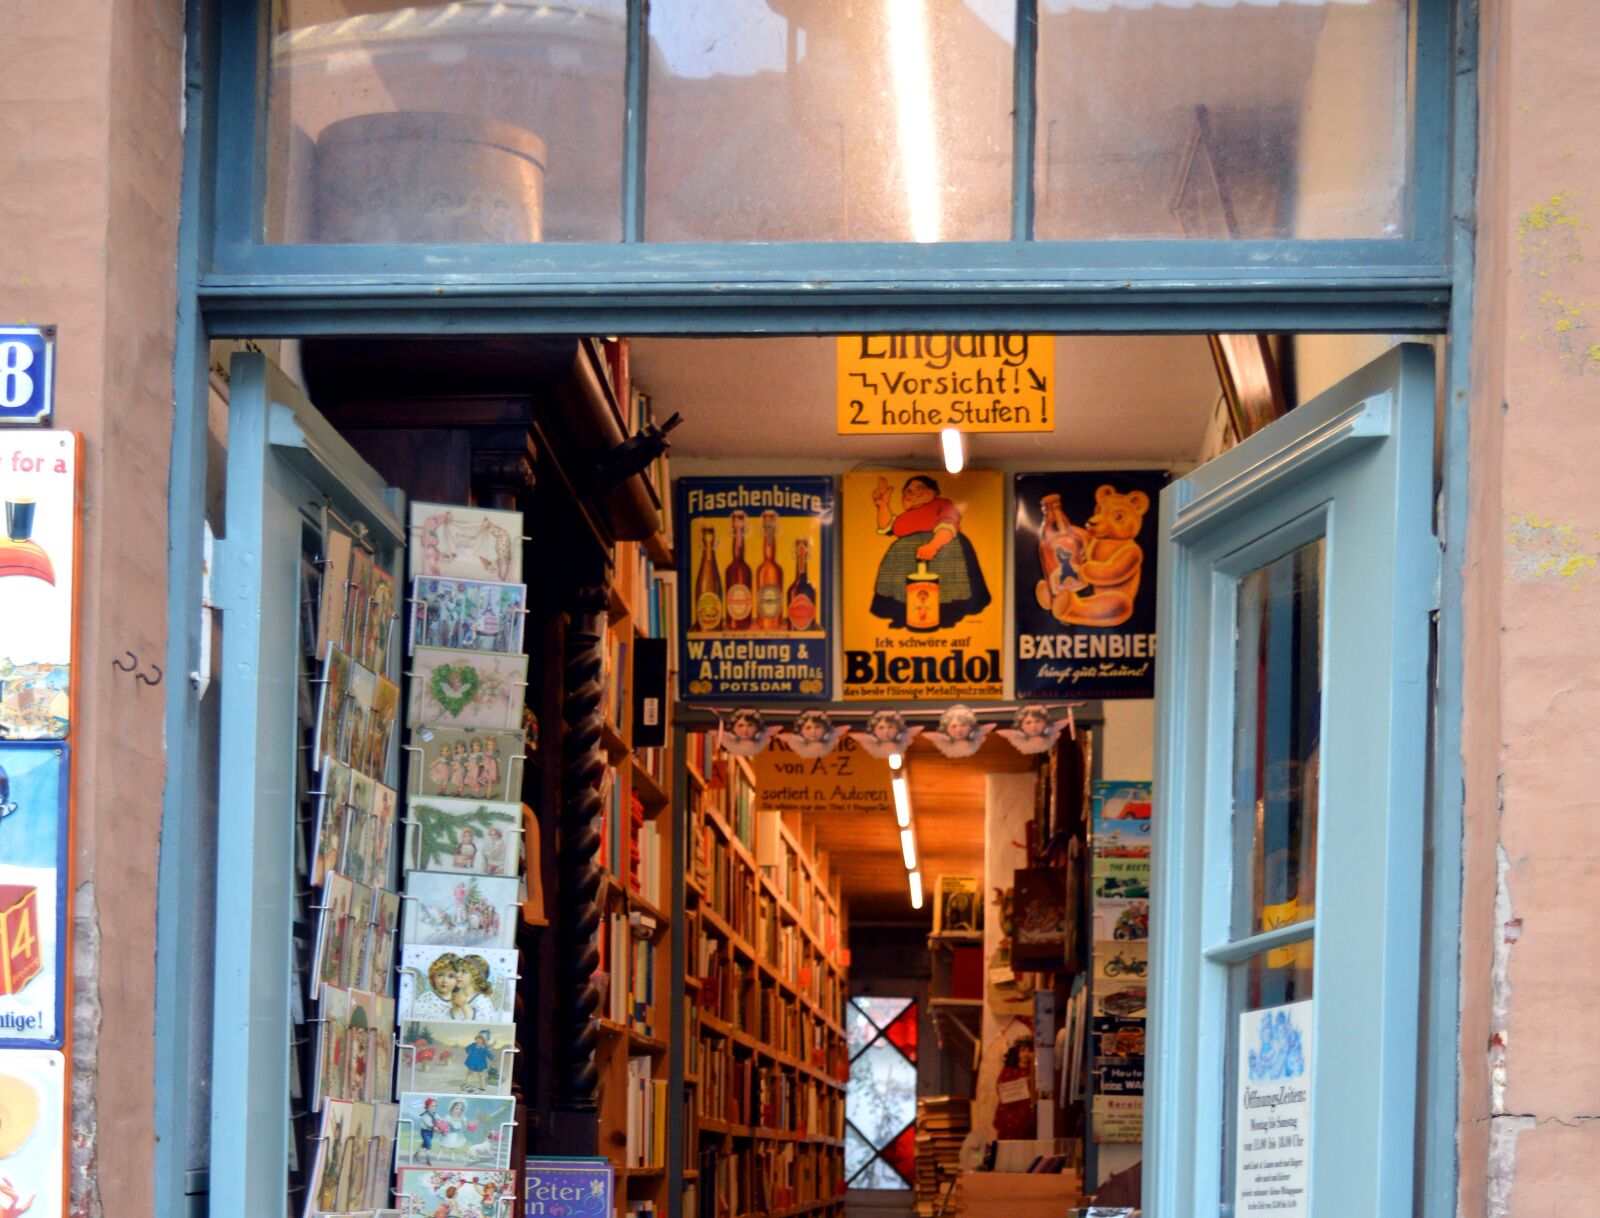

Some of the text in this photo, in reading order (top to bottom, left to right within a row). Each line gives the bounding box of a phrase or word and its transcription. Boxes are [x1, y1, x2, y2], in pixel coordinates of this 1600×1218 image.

[0, 341, 34, 408] 8
[881, 368, 1020, 395] Vorsicht!
[849, 400, 870, 425] 2
[881, 400, 942, 425] hohe
[947, 400, 1031, 424] Stufen
[11, 450, 68, 474] for a
[688, 484, 822, 514] Flaschenbiere
[797, 644, 809, 659] &
[950, 636, 972, 648] auf
[845, 650, 1003, 684] Blendol
[720, 682, 792, 691] POTSDAM
[774, 763, 804, 774] von
[762, 787, 809, 801] sortiert
[830, 786, 888, 801] Autoren
[11, 907, 36, 960] 4
[525, 1177, 585, 1201] Peter
